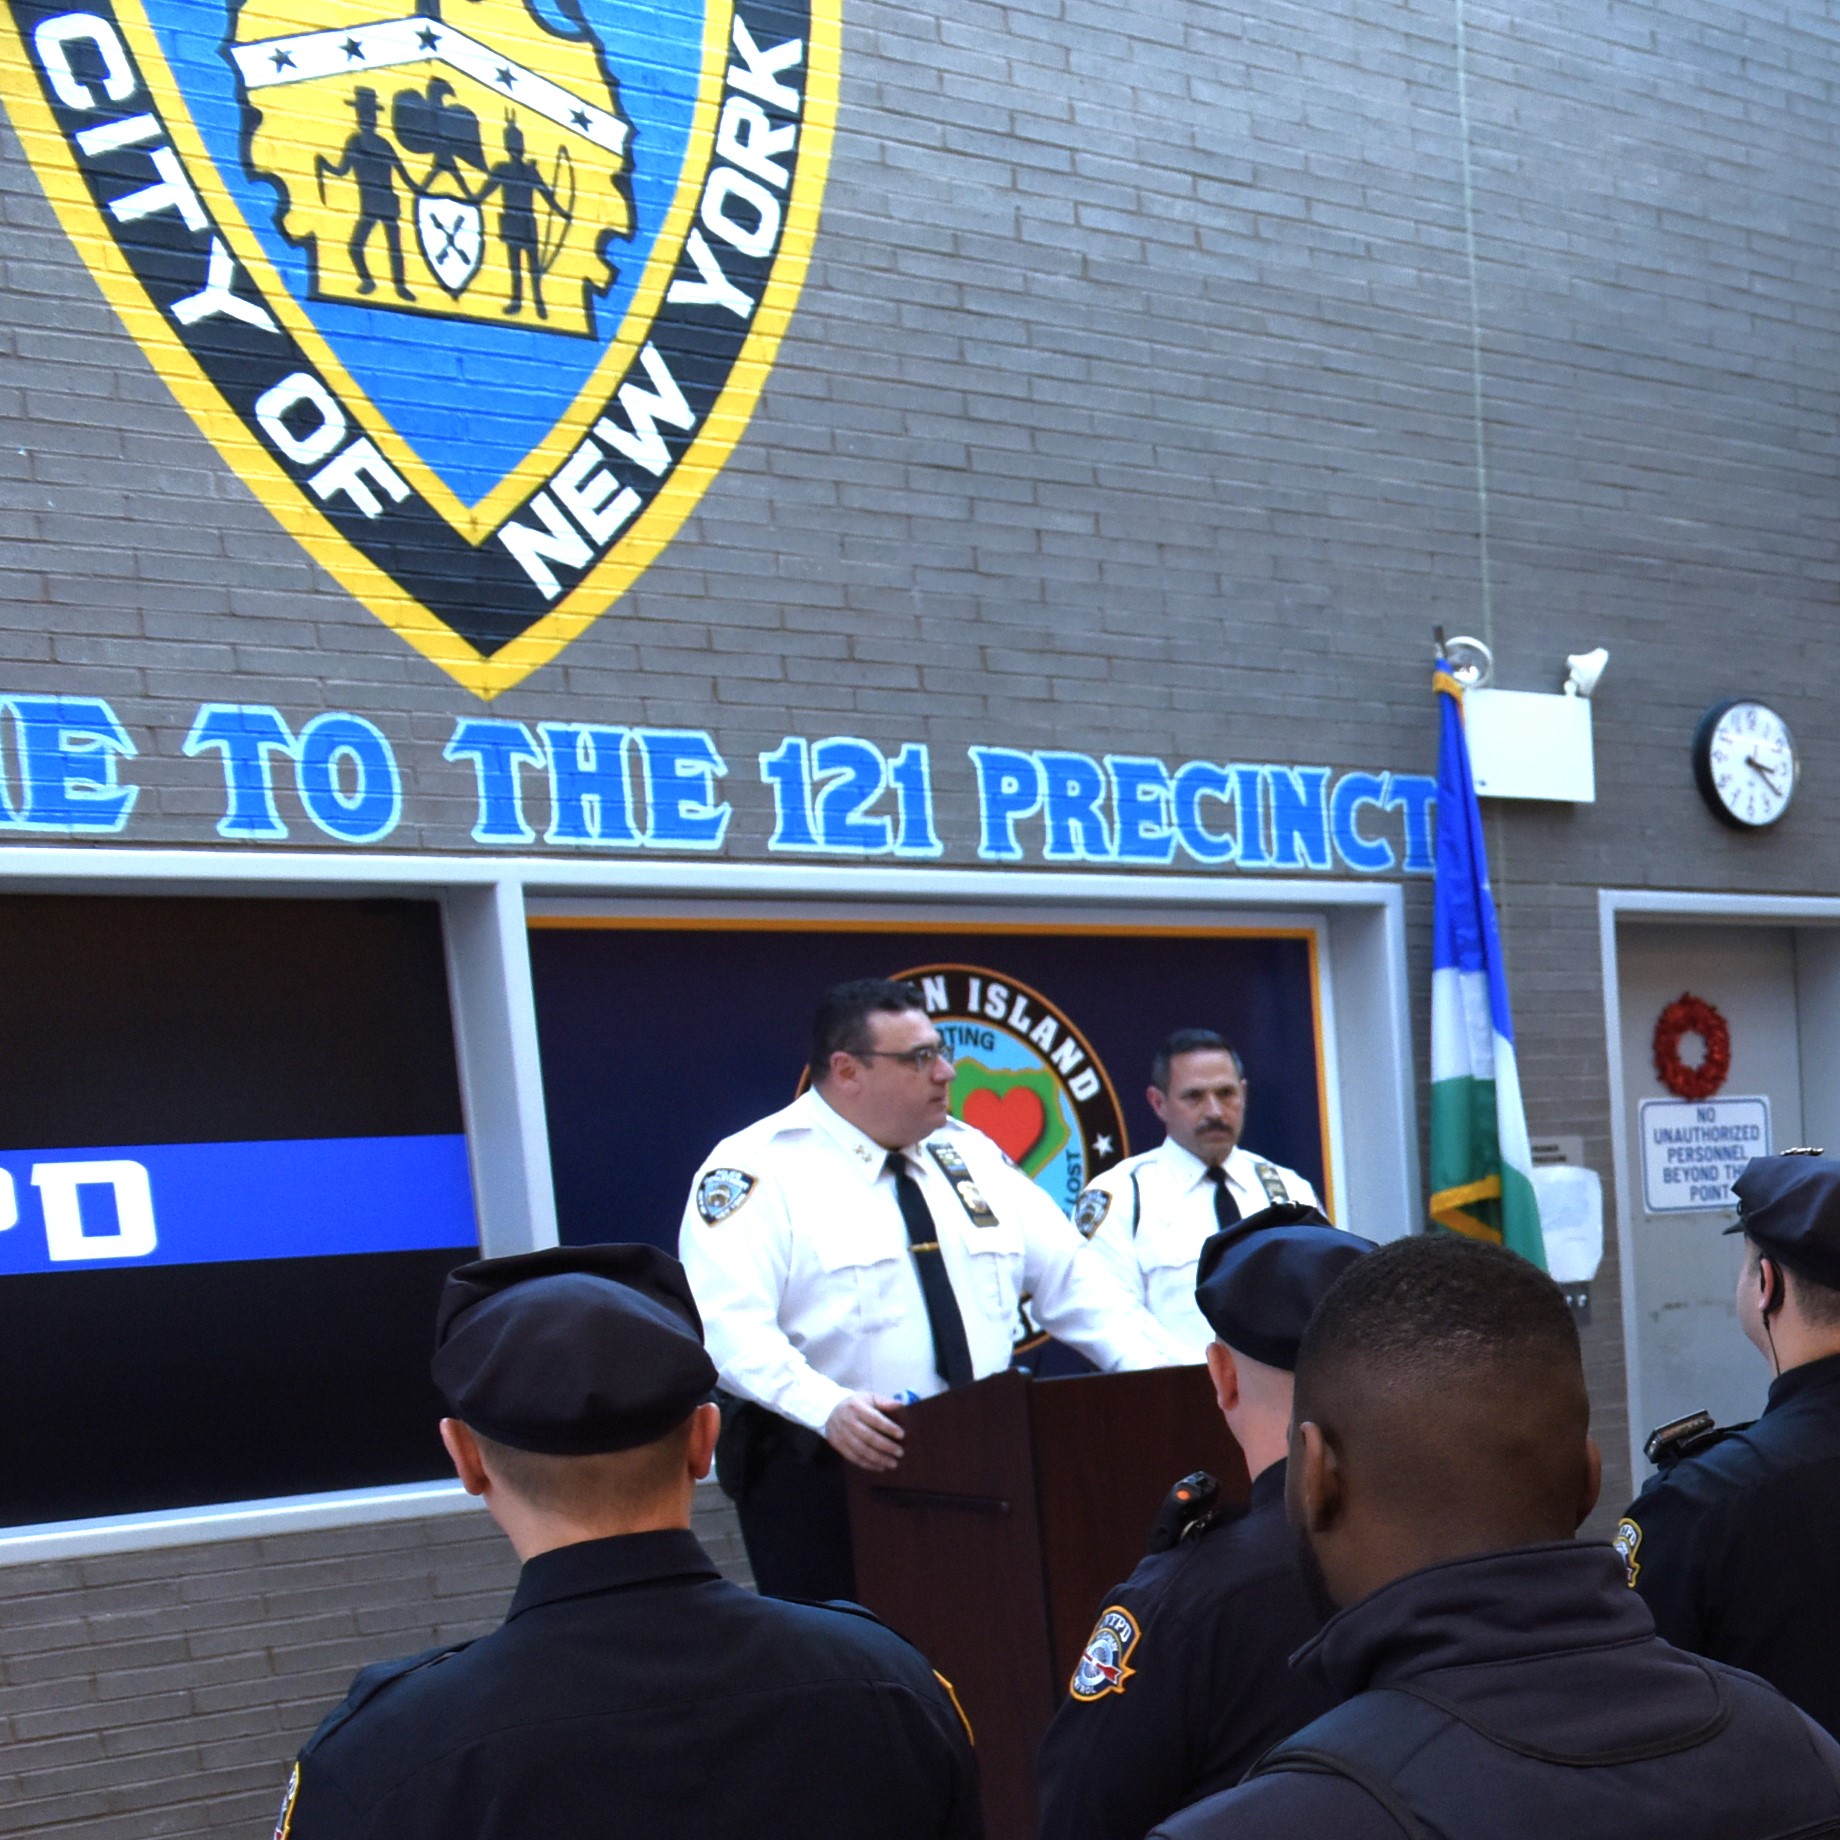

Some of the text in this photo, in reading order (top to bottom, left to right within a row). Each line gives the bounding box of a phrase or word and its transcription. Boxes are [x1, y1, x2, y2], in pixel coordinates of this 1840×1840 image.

[33, 13, 411, 520] CITY OF
[497, 14, 803, 600] NEW YORK
[183, 703, 403, 844] TO
[443, 716, 734, 851] THE
[761, 735, 944, 859] 121
[967, 744, 1437, 873] PRECINCT
[966, 977, 1102, 1102] ISLAND
[1695, 1106, 1717, 1124] NO
[1652, 1124, 1761, 1145] UNAUTHORIZED
[1667, 1146, 1748, 1164] PERSONNEL
[1663, 1165, 1720, 1185] BEYOND
[1689, 1183, 1731, 1202] POINT
